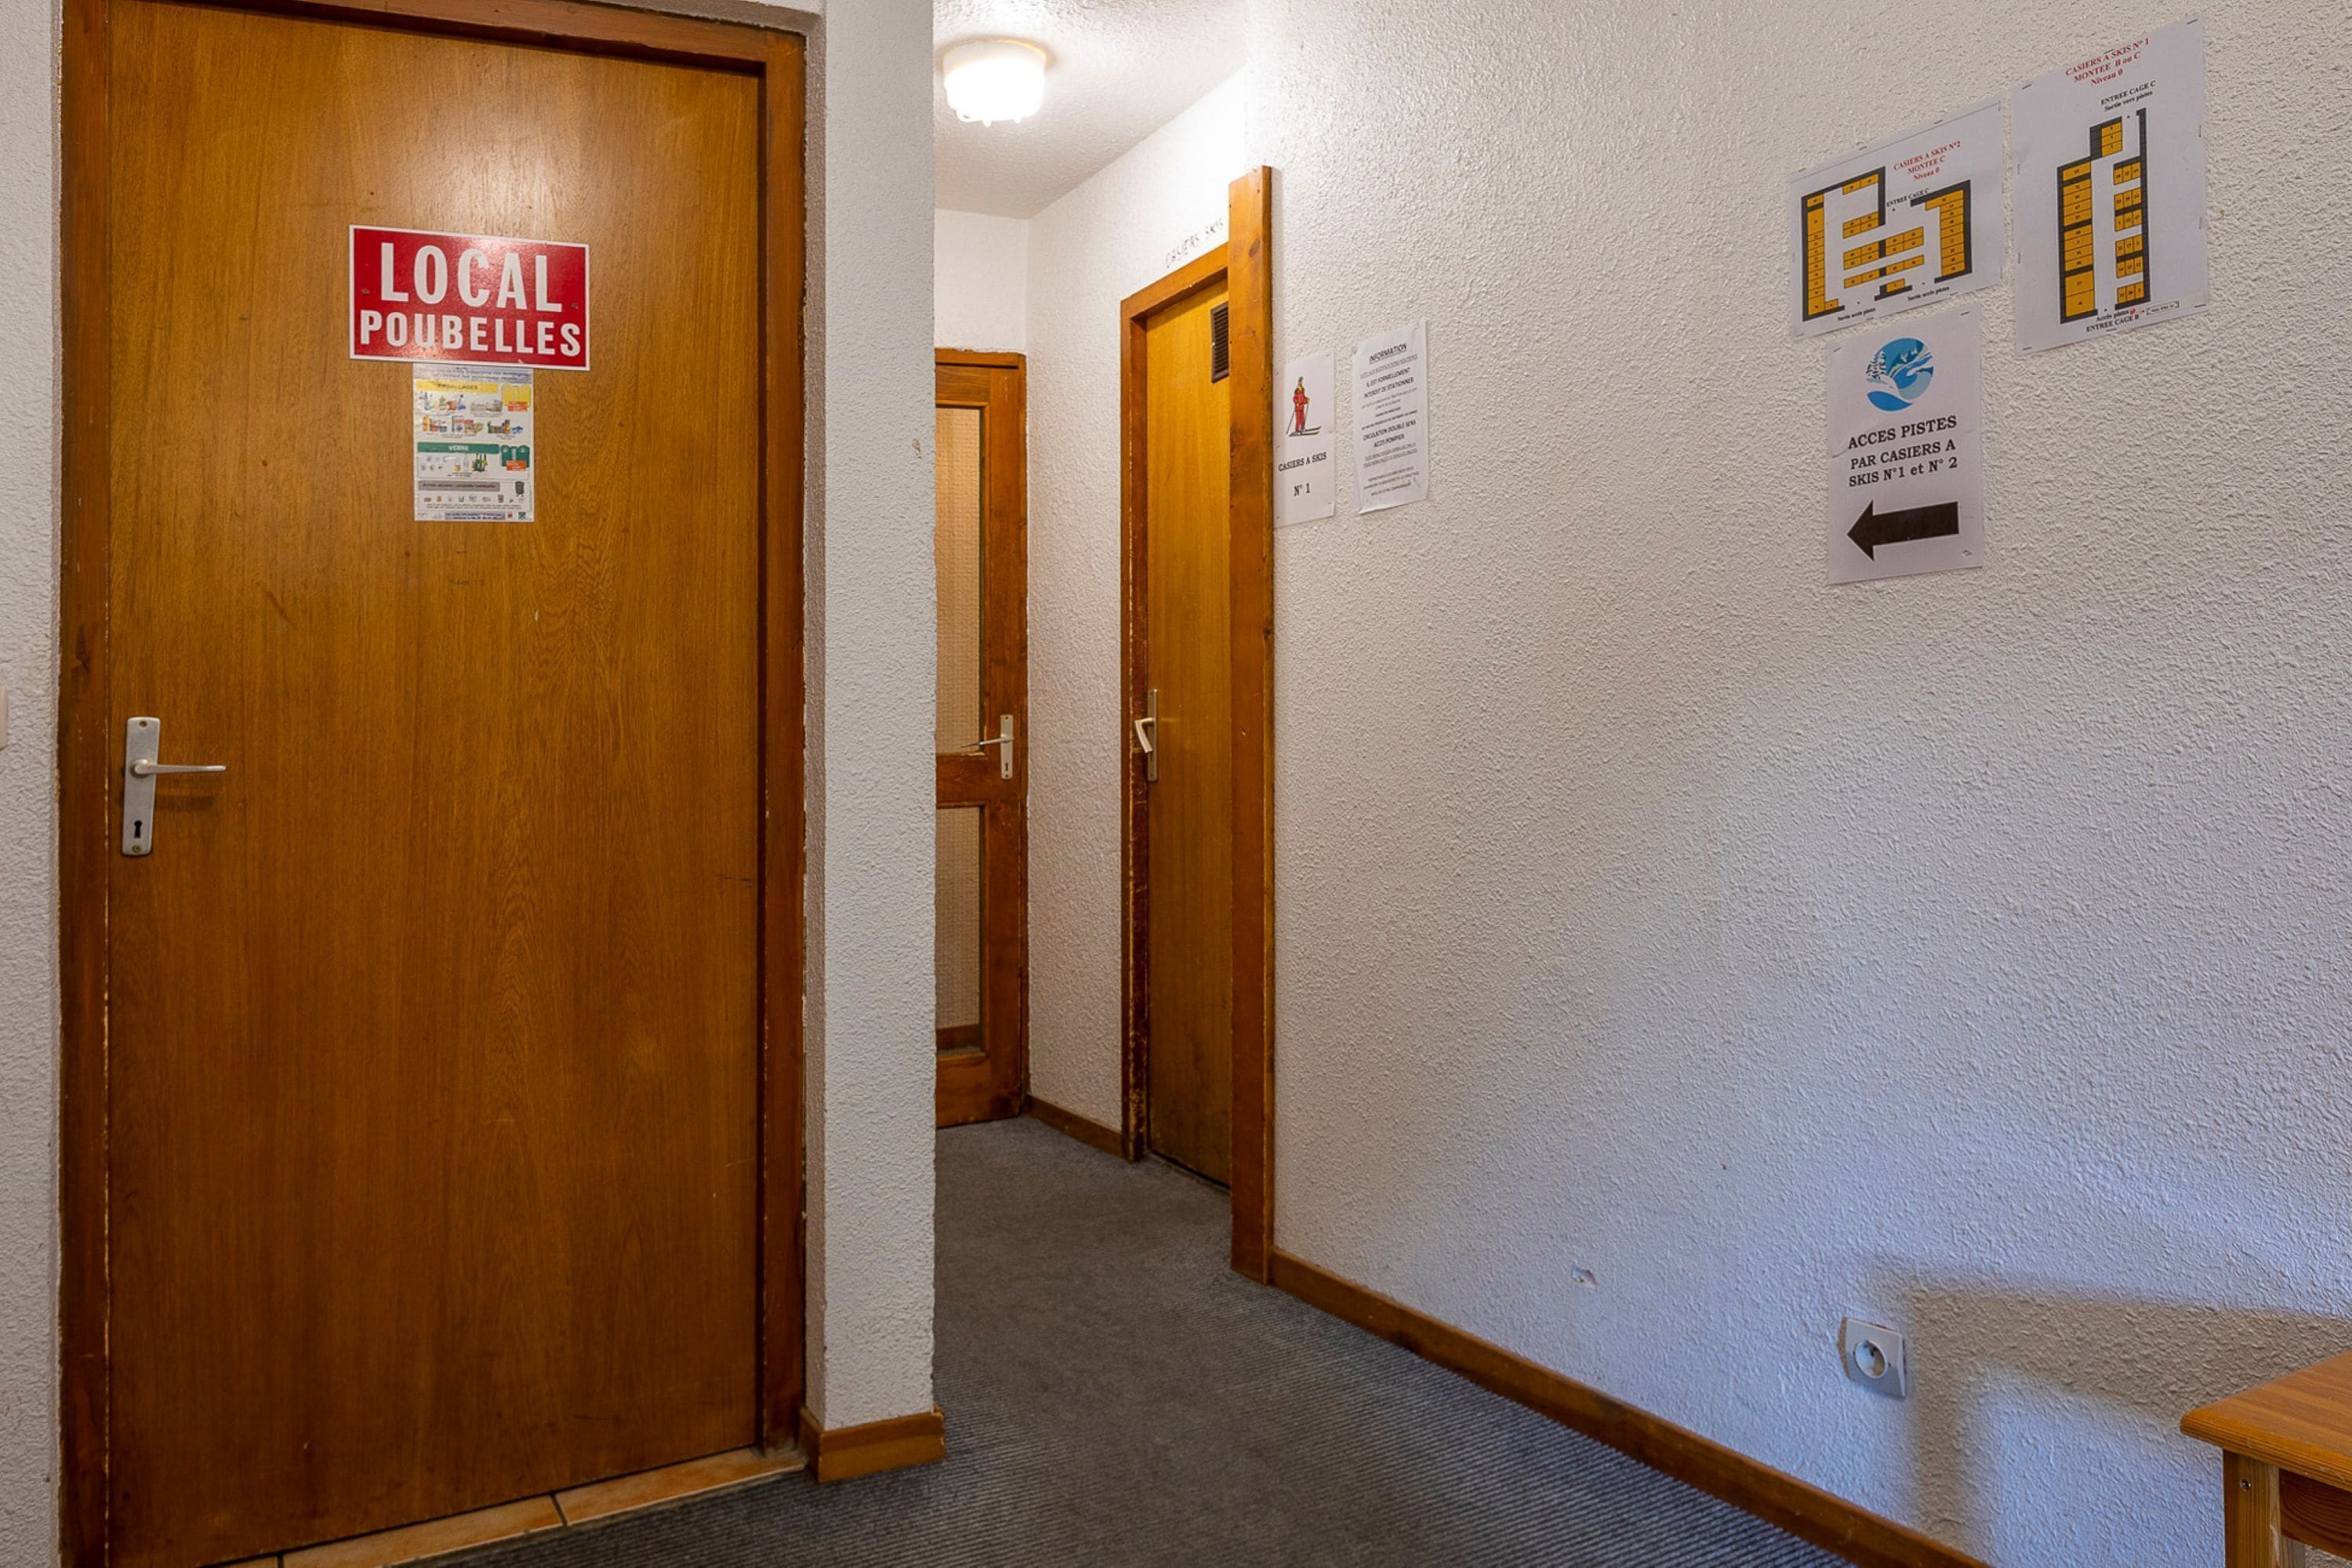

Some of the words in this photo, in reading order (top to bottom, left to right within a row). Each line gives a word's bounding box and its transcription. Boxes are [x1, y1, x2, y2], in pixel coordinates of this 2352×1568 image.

[2066, 56, 2101, 75] CASIERS
[2111, 45, 2131, 58] SKIS
[2074, 64, 2111, 82] MONTEE
[2133, 51, 2141, 60] C
[2091, 72, 2116, 85] Niveau
[2101, 90, 2128, 105] ENTREE
[2129, 82, 2149, 95] CAGE
[1893, 154, 1923, 170] CASIERS
[1907, 158, 1938, 173] MONTEE
[1914, 170, 1934, 181] Niveau
[381, 242, 563, 312] LOCAL
[361, 310, 581, 357] POUBELLES
[2086, 320, 2113, 332] ENTREE
[1848, 428, 1896, 449] ACCES
[1900, 415, 1958, 438] PISTES
[1278, 458, 1305, 471] CASIERS
[1312, 452, 1327, 463] SKIS
[1850, 455, 1876, 470] PAR
[1880, 441, 1941, 464] CASIERS
[1945, 439, 1956, 452] A
[1849, 471, 1879, 487] SKIS
[1911, 464, 1924, 476] et
[1929, 458, 1944, 472] N°
[1949, 456, 1958, 469] 2
[1305, 483, 1310, 493] 1
